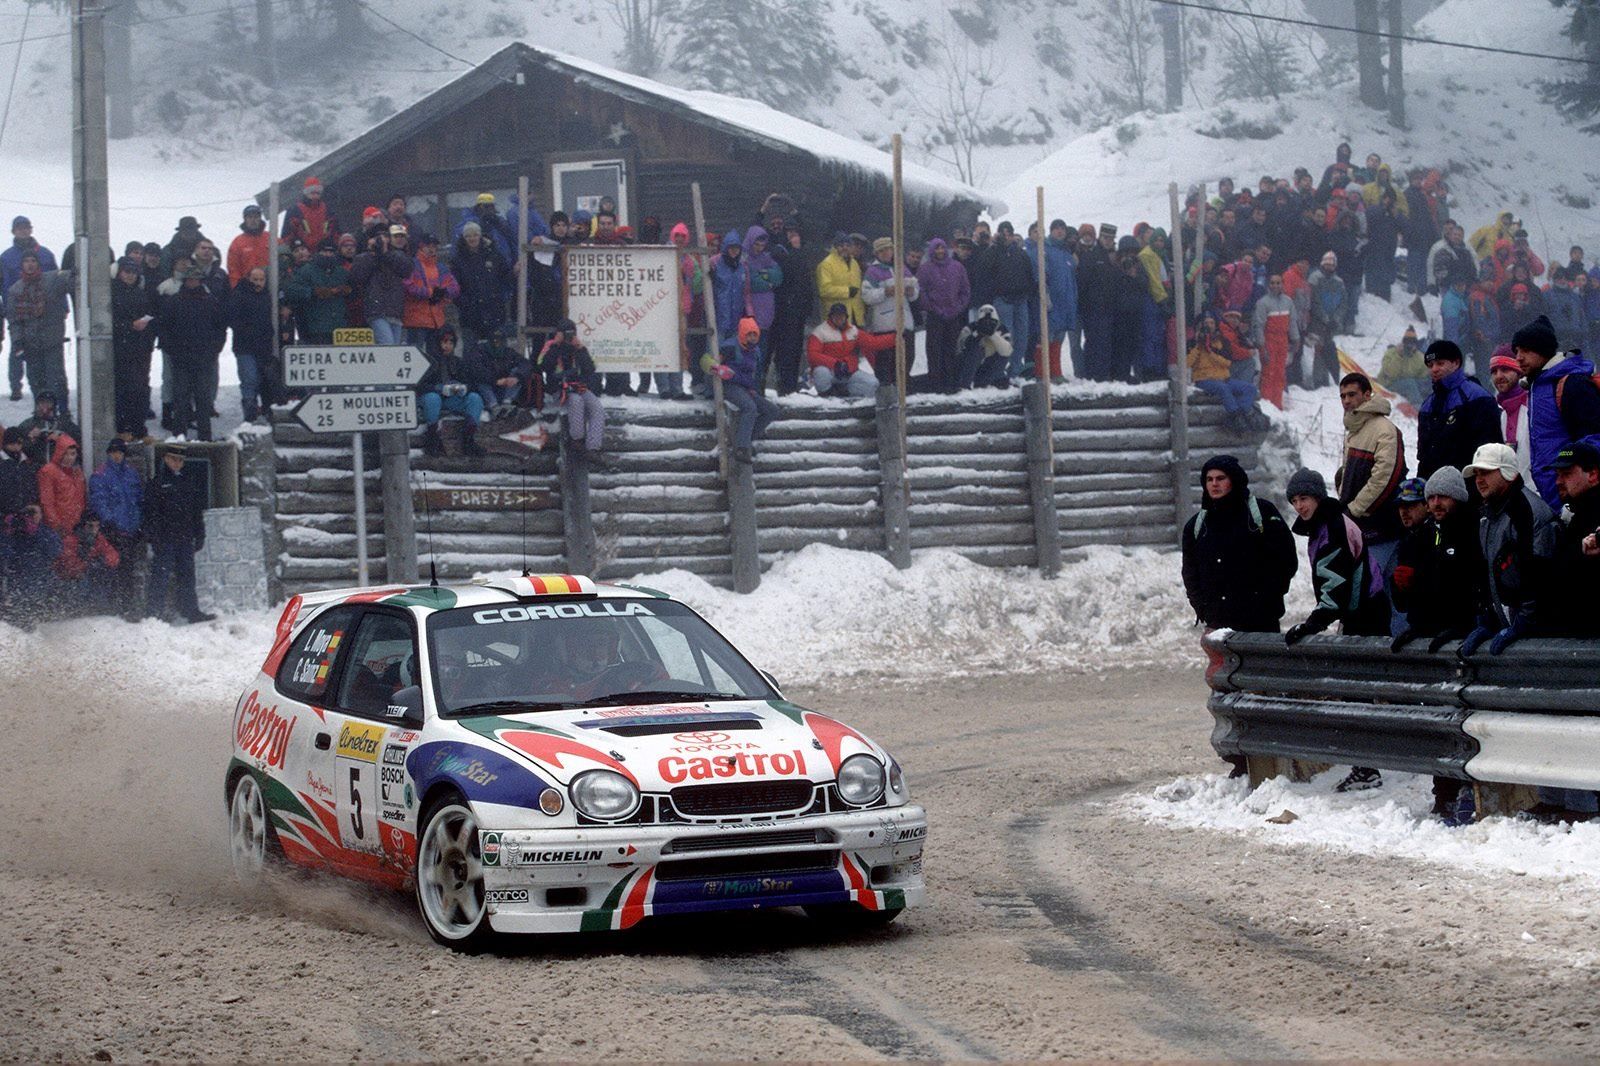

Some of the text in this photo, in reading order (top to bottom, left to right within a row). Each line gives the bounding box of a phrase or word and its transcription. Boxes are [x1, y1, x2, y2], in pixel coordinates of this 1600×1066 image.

[569, 253, 632, 267] AUBERGE
[569, 265, 665, 281] SALON DE THÉ
[335, 330, 373, 343] D2566
[290, 351, 412, 365] PEIRA CAVA 8
[289, 367, 412, 381] NICE 47
[317, 396, 410, 411] 12 MOULINET
[317, 412, 411, 427] 25 SOSPEL
[451, 490, 513, 506] PONEYS
[472, 602, 656, 625] COROLLA
[236, 689, 298, 771] Castrol
[671, 741, 761, 754] TOYOTA
[657, 749, 808, 785] Castrol
[381, 766, 405, 784] BOSCH
[350, 767, 364, 840] 5
[522, 850, 603, 863] MICHELIN
[486, 889, 528, 901] sparco
